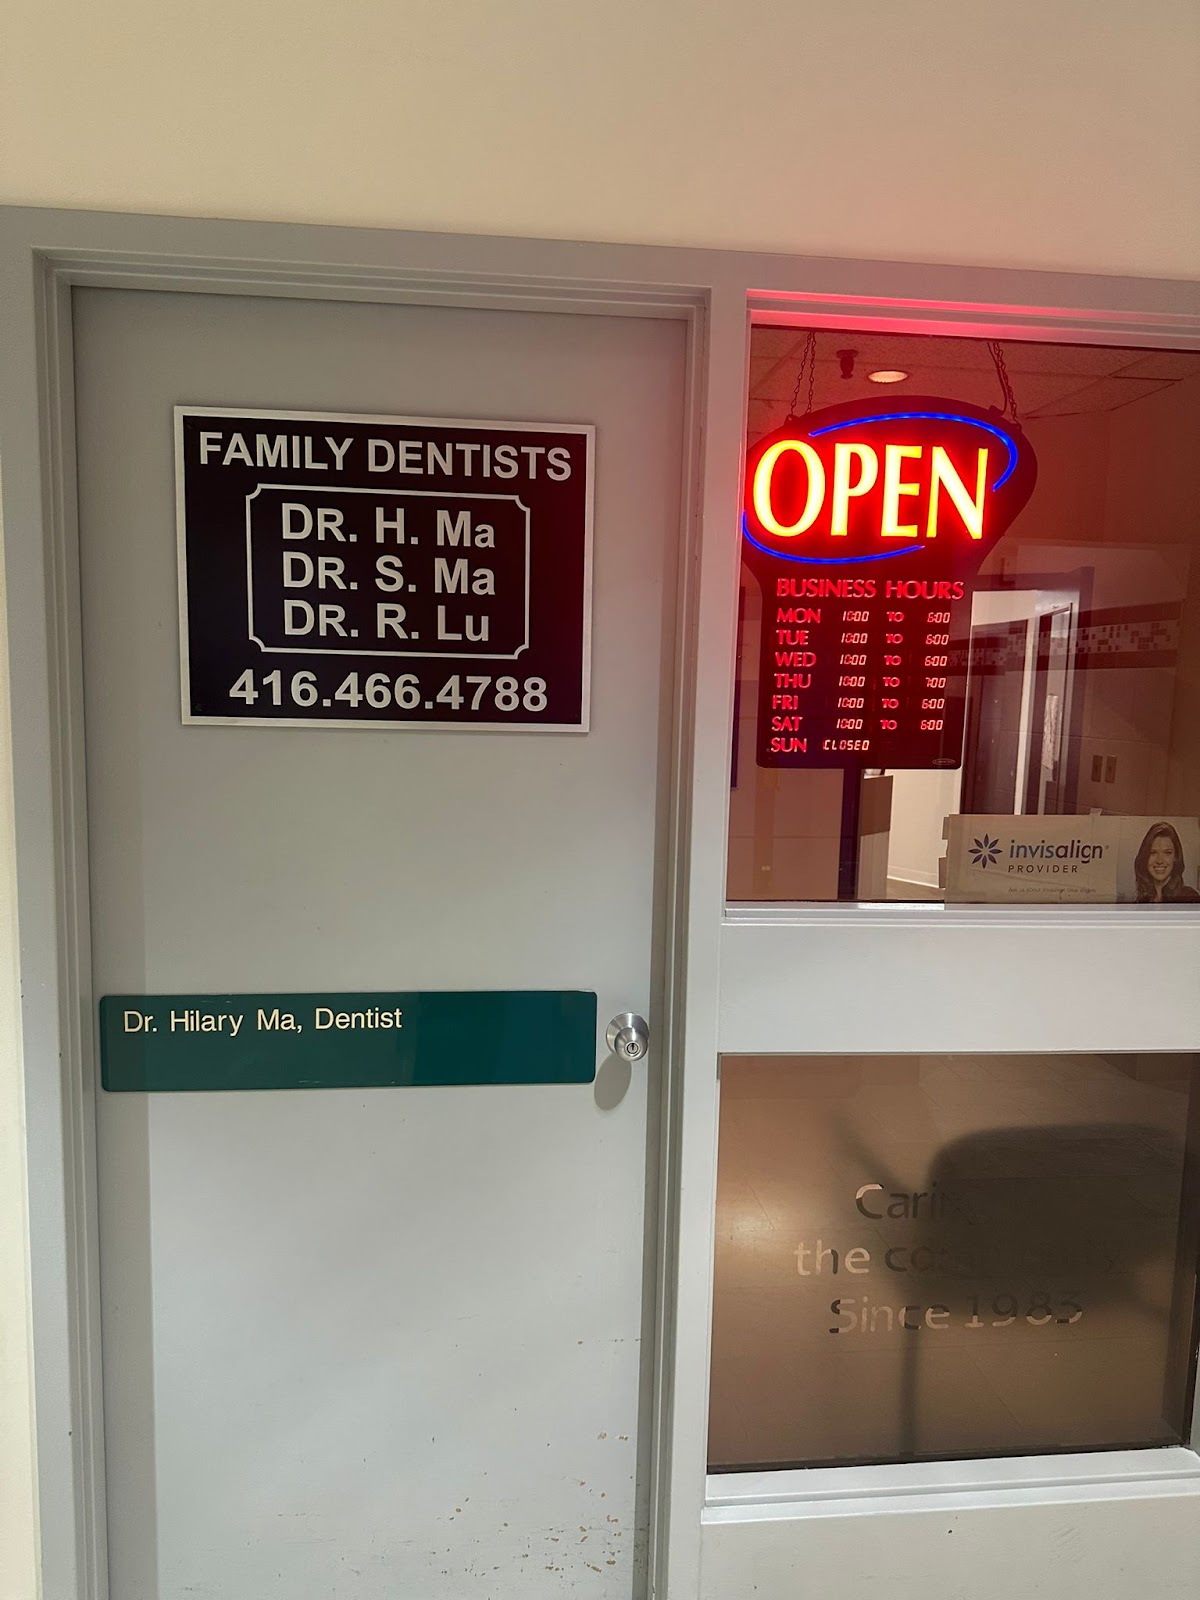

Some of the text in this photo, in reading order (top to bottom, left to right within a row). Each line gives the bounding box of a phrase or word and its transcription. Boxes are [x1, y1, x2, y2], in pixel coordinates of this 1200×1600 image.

[199, 431, 572, 481] FAMILY DENTISTS
[753, 439, 988, 540] OPEN
[281, 503, 496, 549] DR. H. Ma
[282, 551, 496, 596] DR. S. Ma
[776, 578, 965, 600] BUSINESS HOURS
[283, 599, 489, 642] DR. R. Lu
[776, 608, 821, 624] MON
[886, 611, 905, 623] TO
[776, 629, 810, 645] TUE
[885, 633, 904, 644] TO
[775, 651, 817, 667] WED
[883, 655, 902, 666] TO
[229, 669, 548, 712] 416.466.4788
[774, 673, 812, 689] THU
[882, 676, 901, 688] TO
[772, 694, 799, 710] FRI
[881, 698, 900, 709] TO
[771, 716, 803, 731] SAT
[879, 719, 898, 730] TO
[770, 737, 870, 753] SUN CLOSED
[1009, 839, 1104, 864] invisalign
[1008, 864, 1078, 873] PROVIDER
[123, 1006, 403, 1036] Dr. Hilary Ma, Dentist
[793, 1239, 871, 1276] the
[829, 1292, 1083, 1334] Since 1983
